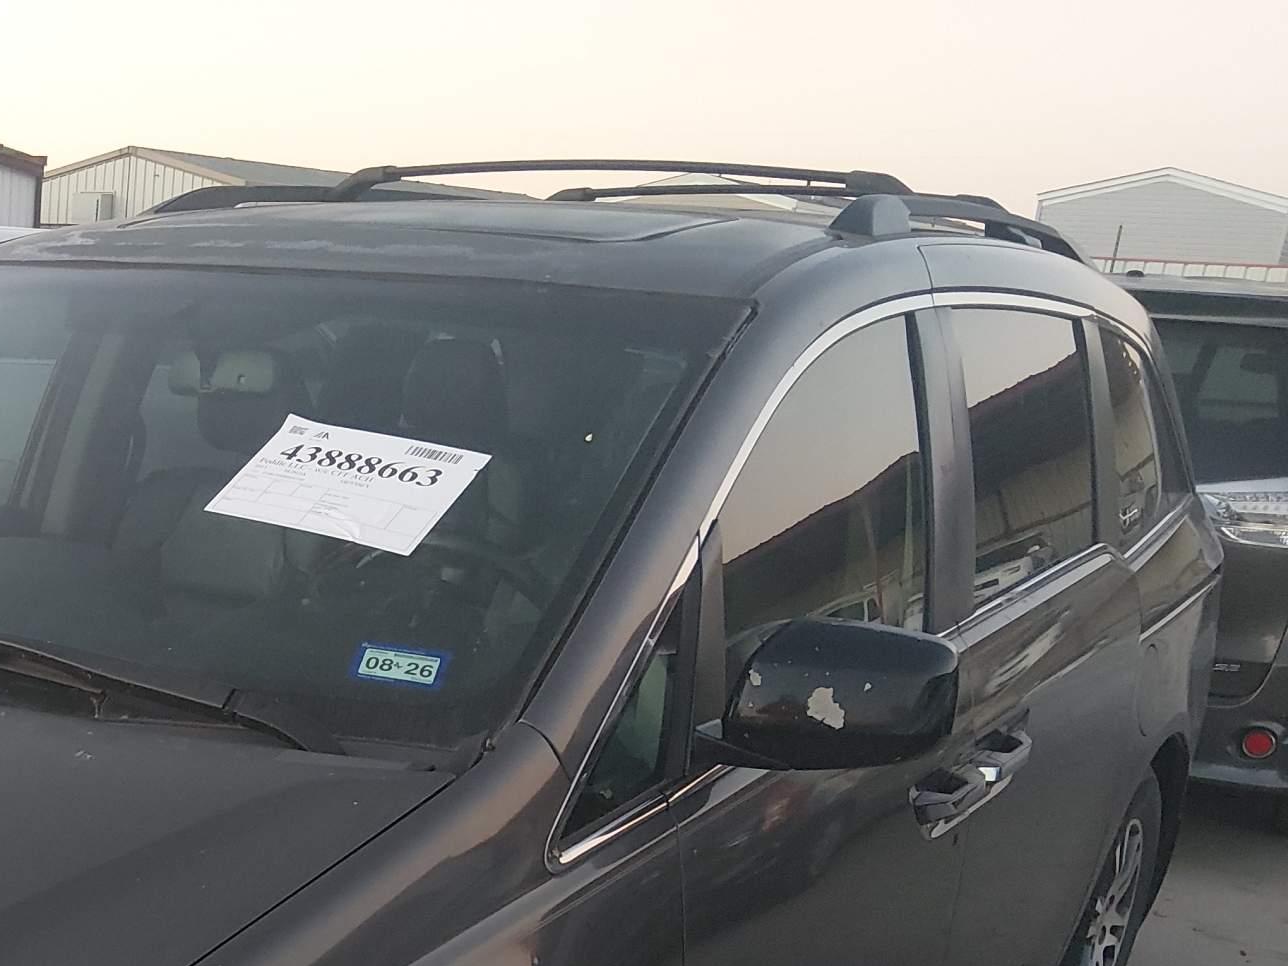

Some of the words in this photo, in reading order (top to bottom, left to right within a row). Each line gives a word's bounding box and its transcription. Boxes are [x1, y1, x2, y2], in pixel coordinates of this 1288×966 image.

[279, 443, 443, 487] 43888663
[364, 656, 395, 672] 08
[403, 662, 435, 678] 26
